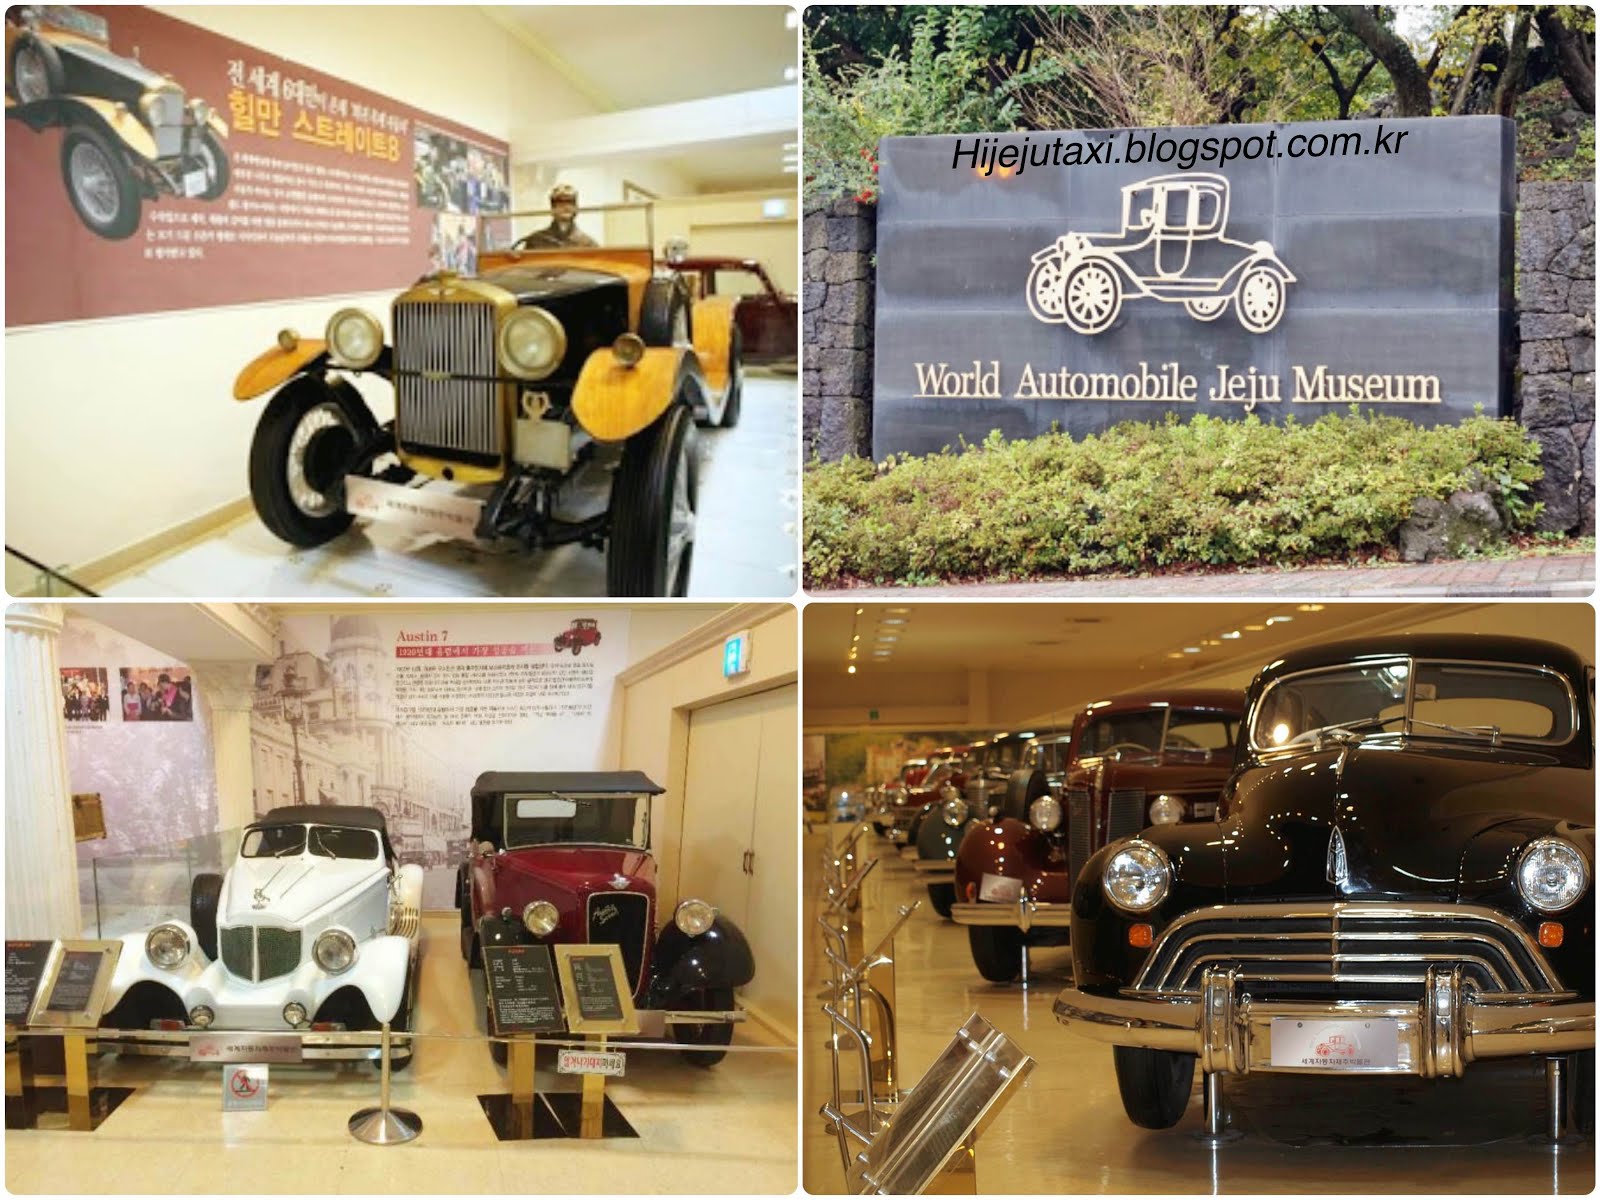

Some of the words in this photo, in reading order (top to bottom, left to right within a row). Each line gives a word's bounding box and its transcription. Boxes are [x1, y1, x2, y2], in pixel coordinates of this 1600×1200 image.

[227, 60, 245, 88] 전
[249, 66, 280, 98] 세계
[228, 87, 281, 137] 힐만
[292, 109, 400, 162] 스트레이트8
[914, 362, 1001, 397] World
[1014, 363, 1197, 400] Automobile
[1209, 365, 1281, 411] Jeju
[1293, 366, 1441, 402] Museum
[397, 630, 437, 642] Austin
[441, 630, 449, 641] 7
[398, 646, 432, 656] 1920년대
[1301, 1057, 1371, 1066] 세계자동차제주박물관
